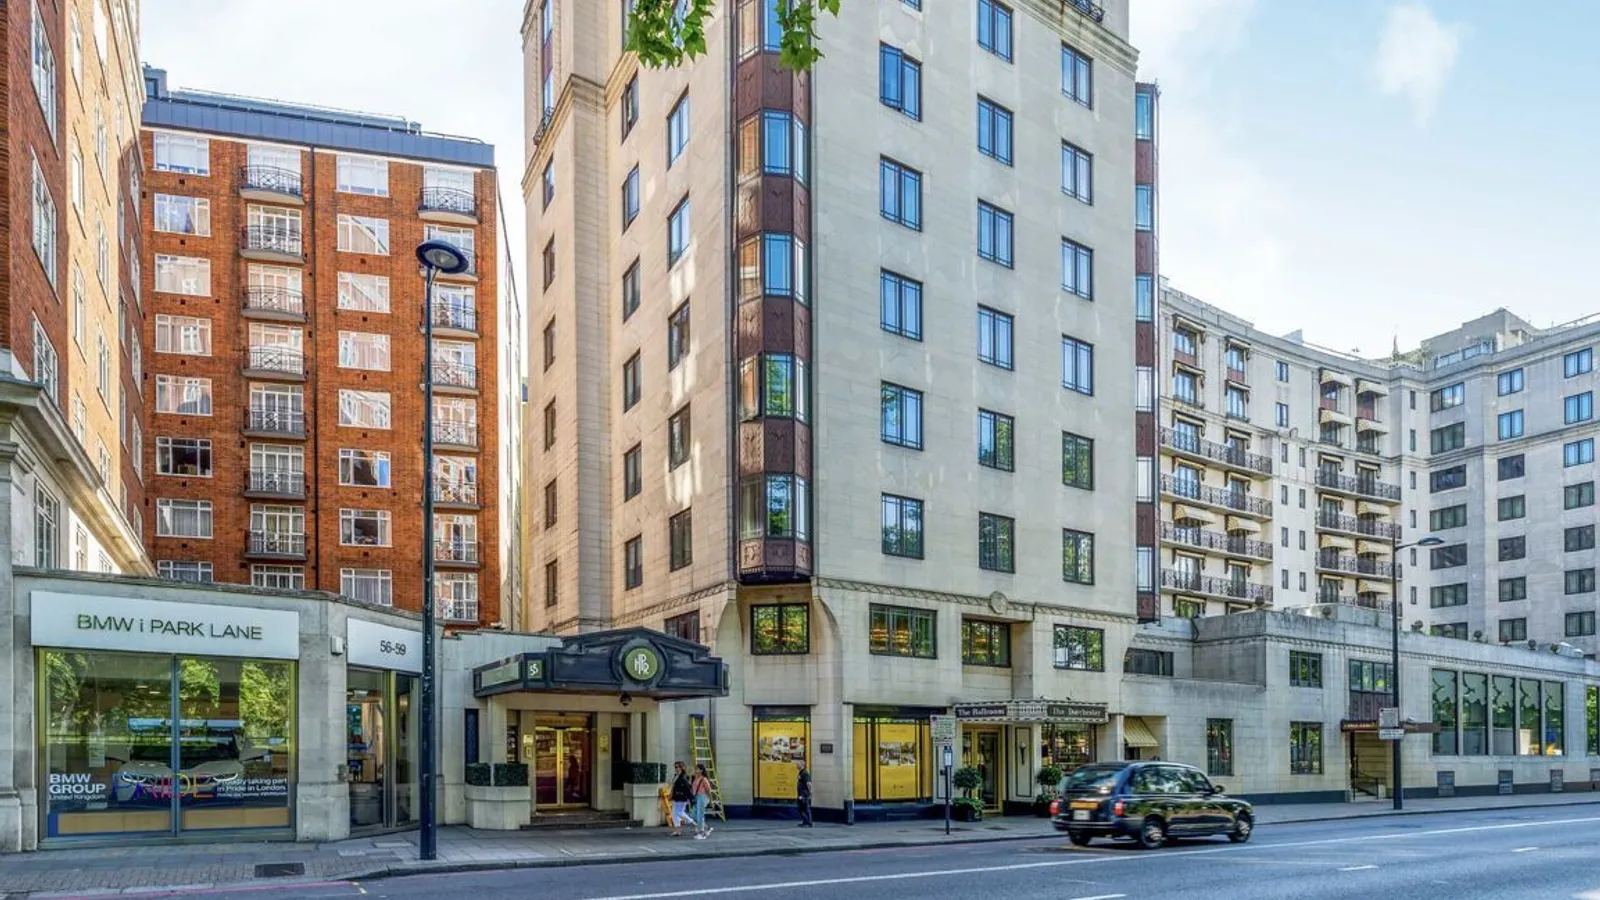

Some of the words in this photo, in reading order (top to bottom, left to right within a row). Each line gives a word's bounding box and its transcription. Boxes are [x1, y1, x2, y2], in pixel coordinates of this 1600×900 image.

[77, 614, 134, 632] BMW
[139, 618, 144, 632] i
[150, 619, 204, 637] PARK
[210, 623, 262, 640] LANE
[380, 640, 407, 656] 56-59
[972, 707, 1005, 716] Ballroom
[1053, 707, 1065, 715] The
[1068, 707, 1102, 716] Dorchester
[50, 773, 91, 783] BMW
[272, 778, 287, 786] part
[49, 783, 106, 794] GROUP
